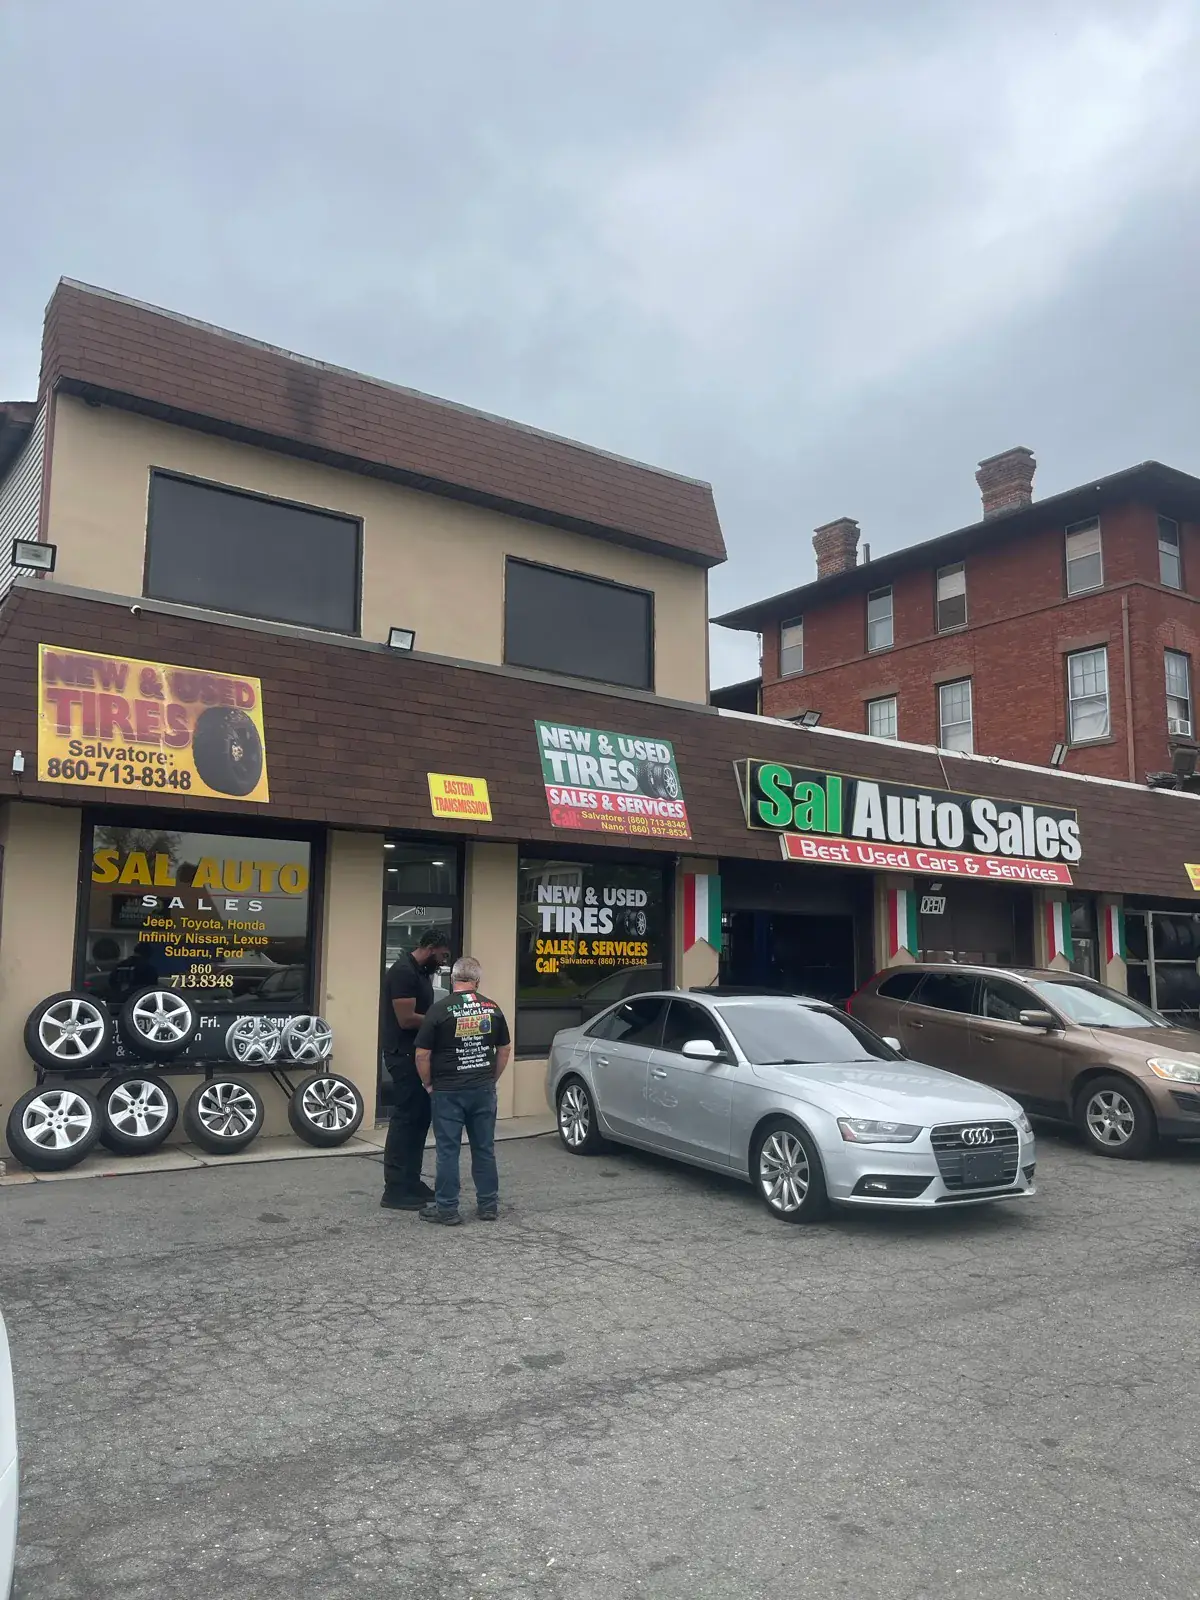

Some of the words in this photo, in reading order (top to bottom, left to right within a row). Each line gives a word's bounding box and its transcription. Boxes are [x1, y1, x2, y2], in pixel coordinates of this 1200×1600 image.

[46, 652, 129, 691] NEW
[140, 667, 165, 700] &
[171, 672, 255, 709] USED
[46, 688, 191, 748] TIRES
[68, 740, 174, 766] Salvatore:
[539, 725, 591, 752] NEW
[598, 734, 616, 756] &
[618, 738, 671, 764] USED
[47, 758, 191, 790] 860-713-8348
[544, 750, 639, 792] TIRES
[443, 779, 475, 796] EASTERN
[434, 796, 489, 815] TRANSMISSION
[549, 788, 598, 809] SALES
[601, 795, 615, 811] &
[617, 797, 685, 818] SERVICES
[581, 810, 626, 823] Salvatore:
[627, 816, 648, 826] (860)
[650, 818, 686, 829] 713-8348
[758, 764, 842, 834] Sal
[851, 780, 964, 848] Auto
[971, 798, 1082, 862] Sales
[601, 821, 627, 832] Nano:
[629, 825, 650, 835] (860)
[652, 826, 688, 837] 937-8534
[800, 839, 851, 862] Best
[857, 845, 909, 868] Used
[916, 852, 959, 873] Cars
[964, 856, 980, 874] &
[986, 860, 1059, 882] Services
[91, 848, 176, 887] SAL
[192, 857, 309, 894] AUTO
[141, 894, 263, 912] SALES
[537, 884, 580, 904] NEW
[584, 886, 599, 905] &
[603, 888, 648, 907] USED
[922, 897, 945, 913] OPEN
[142, 916, 176, 929] Jeep,
[180, 917, 224, 930] Toyota,
[227, 919, 266, 930] Honda
[537, 905, 614, 934] TIRES
[138, 931, 181, 945] Infinity
[185, 932, 229, 945] Nissan,
[233, 934, 269, 945] Lexus
[535, 939, 575, 955] SALES
[578, 940, 589, 955] &
[592, 941, 648, 956] SERVICES
[164, 946, 212, 959] Subaru,
[215, 947, 244, 958] Ford
[560, 957, 597, 966] Salvatore:
[598, 957, 616, 967] (860)
[190, 963, 212, 974] 860
[535, 957, 559, 973] Call:
[170, 974, 234, 988] 713.8348
[200, 1016, 221, 1028] Fri.
